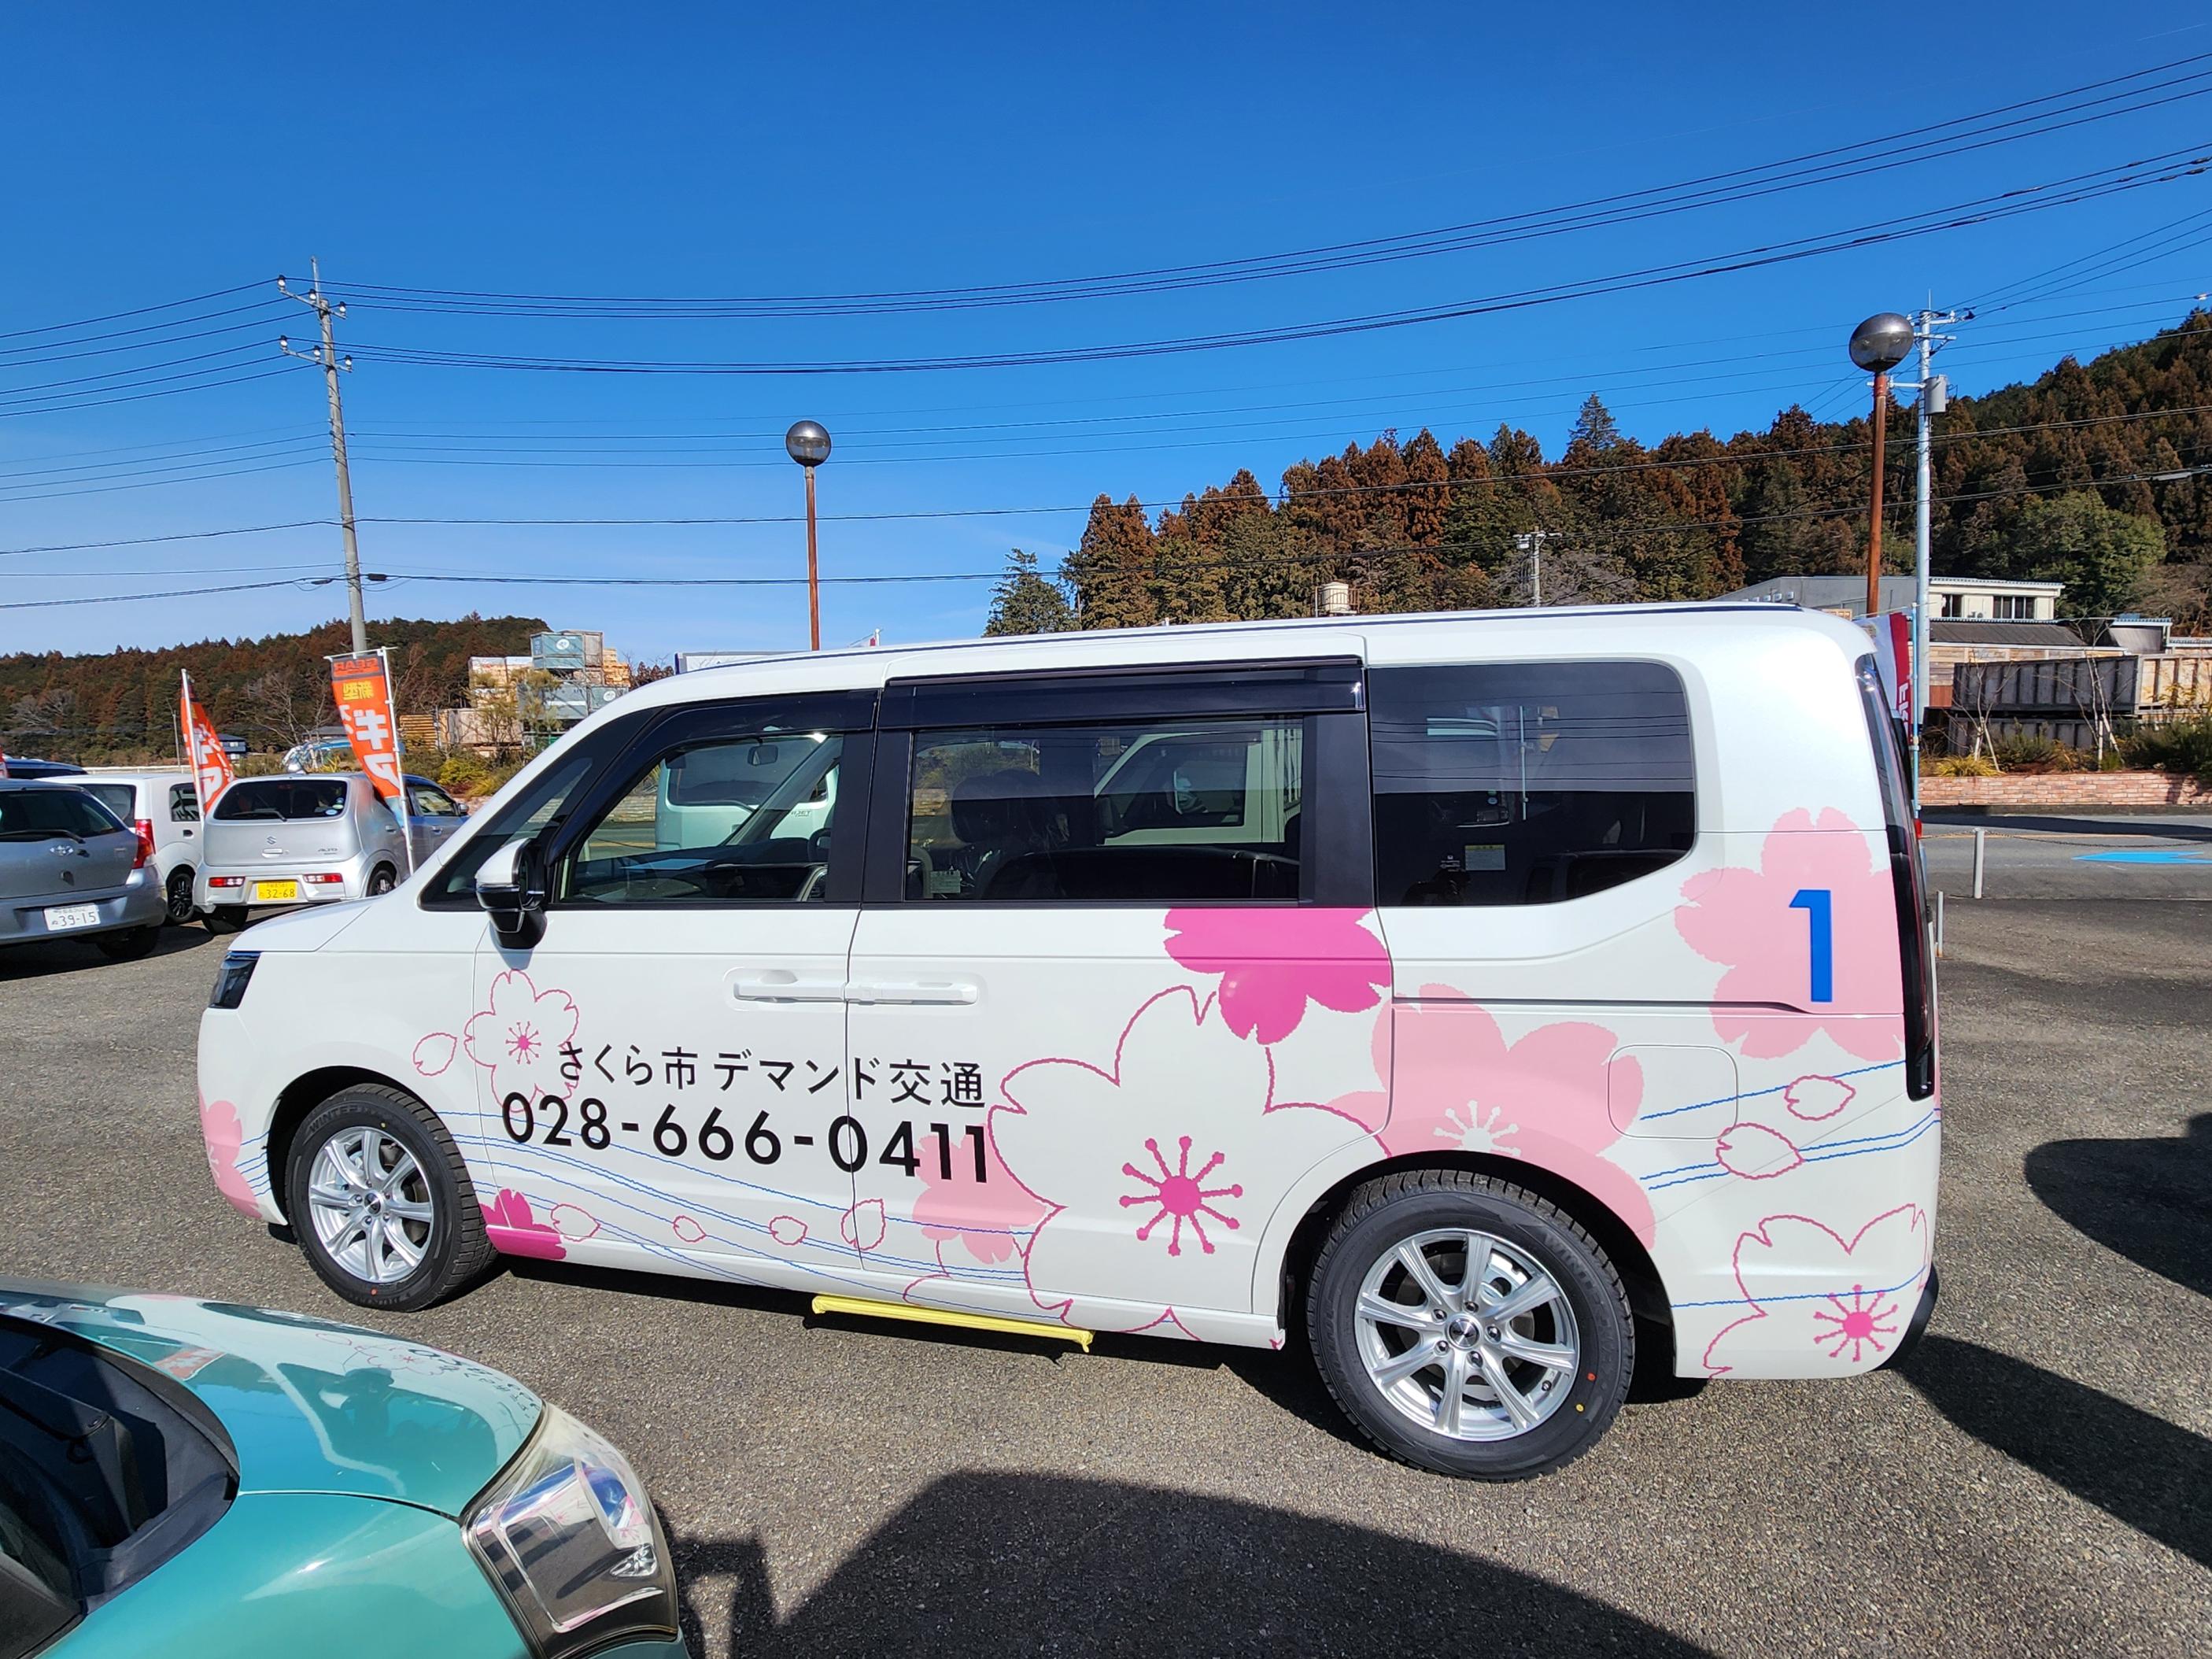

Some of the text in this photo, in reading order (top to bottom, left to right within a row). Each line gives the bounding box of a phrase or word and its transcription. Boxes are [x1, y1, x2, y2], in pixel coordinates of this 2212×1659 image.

[58, 911, 97, 927] 39-15
[265, 889, 295, 899] 32-68
[1789, 889, 1833, 1002] 1
[501, 1091, 988, 1184] 028-666-0411
